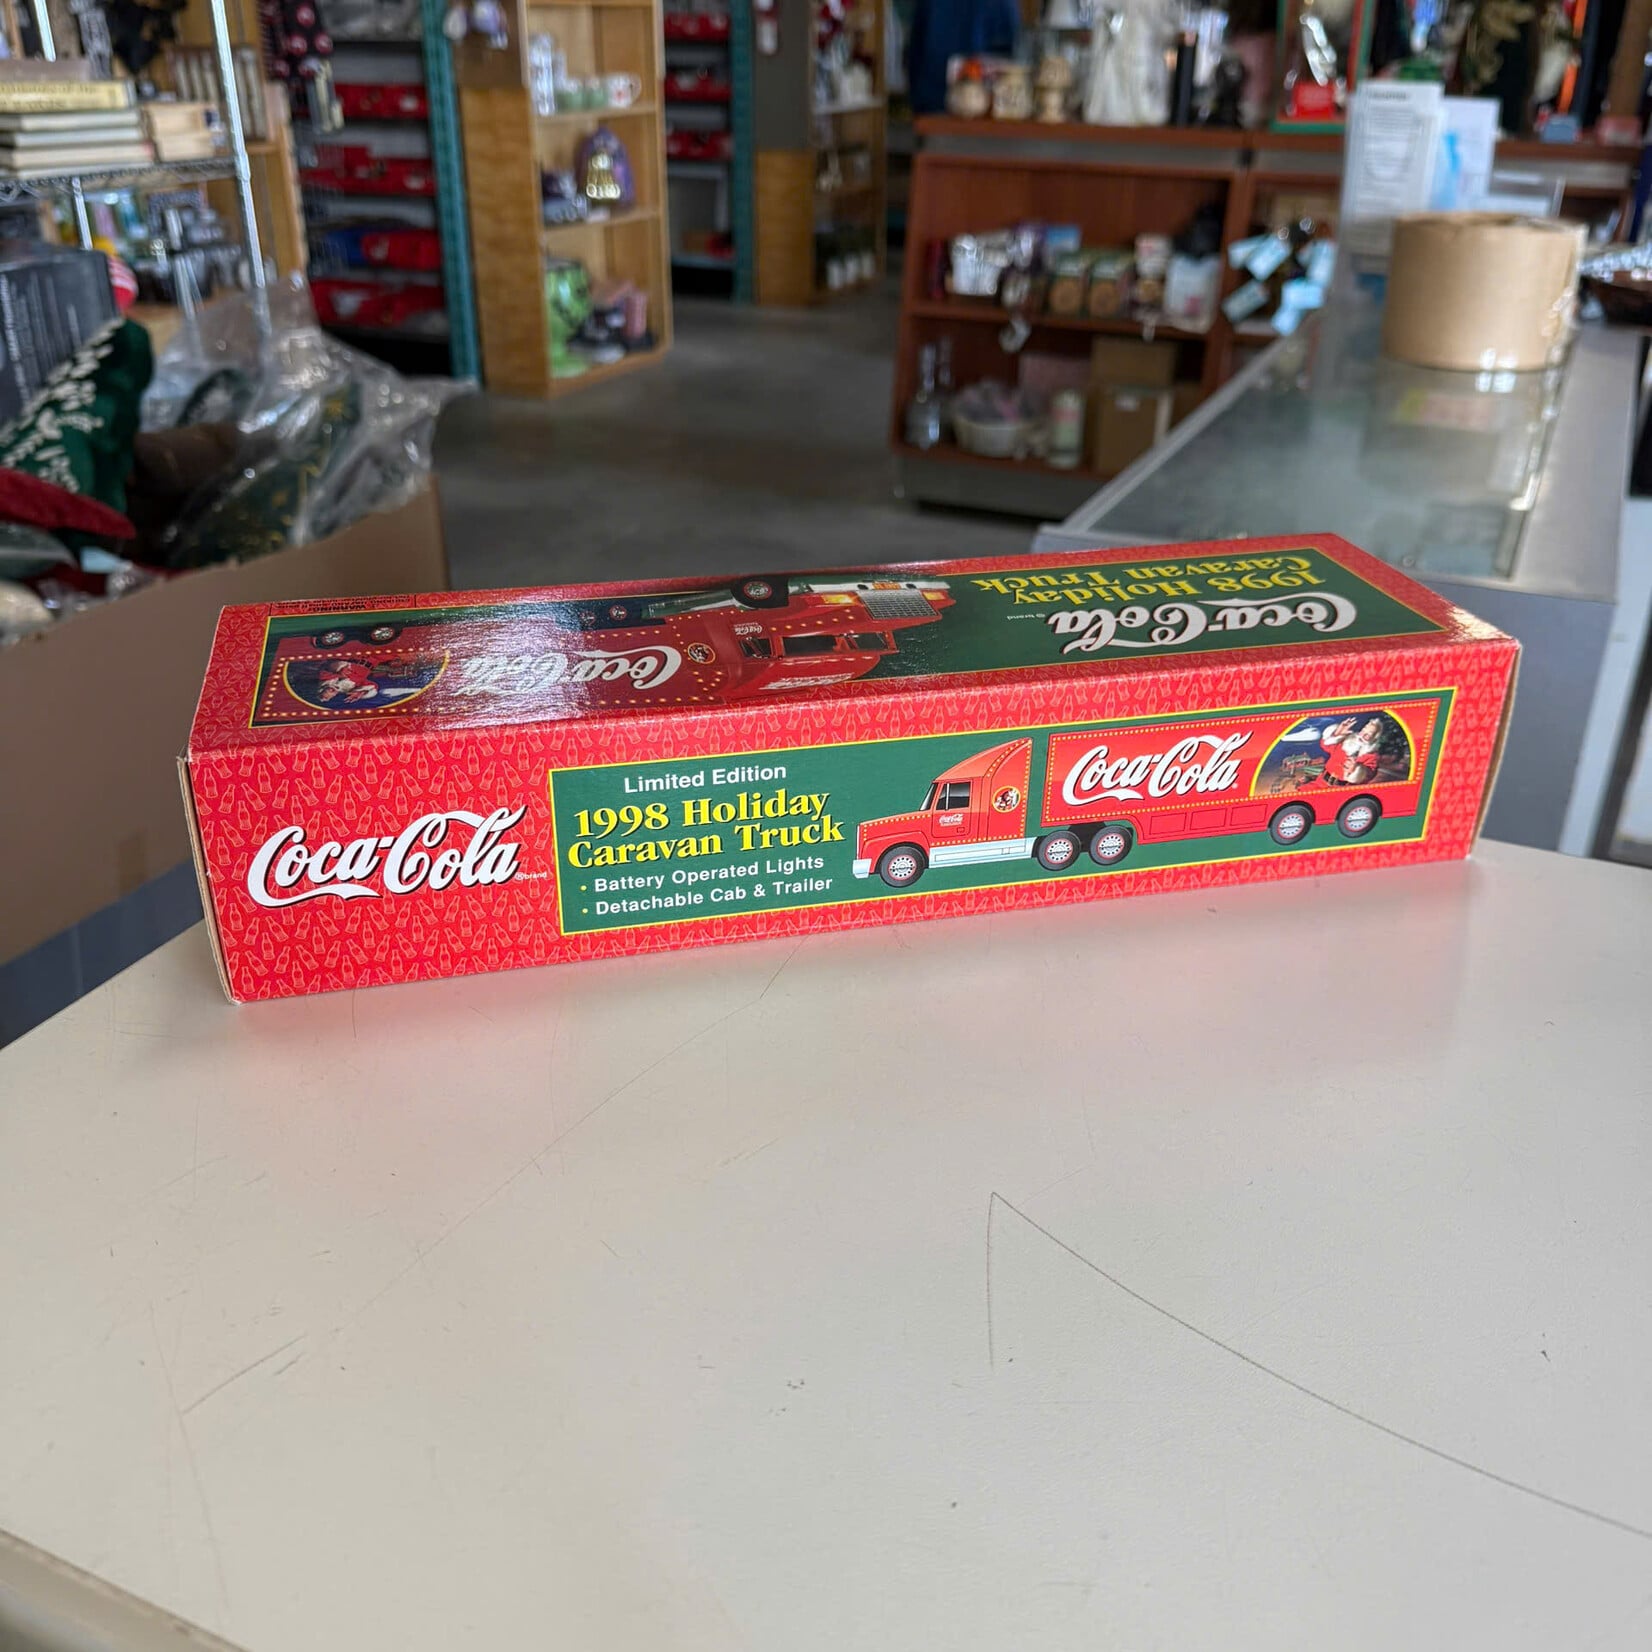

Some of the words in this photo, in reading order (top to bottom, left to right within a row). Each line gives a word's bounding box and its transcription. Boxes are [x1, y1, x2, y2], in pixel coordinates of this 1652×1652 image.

[971, 570, 1120, 596] Truck
[1122, 556, 1313, 579] Caravan
[1207, 570, 1326, 593] 1998
[1012, 579, 1203, 606] Holiday
[1048, 592, 1358, 655] Coca-Cola
[624, 770, 705, 794] Limited
[712, 764, 787, 786] Edition
[1062, 730, 1254, 806] Coca-Cola
[573, 801, 671, 839] 1998
[681, 788, 831, 828] Holiday
[247, 804, 527, 908] Coca-Cola
[567, 832, 724, 869] Caravan
[734, 814, 847, 851] Truck
[594, 873, 665, 893] Battery
[671, 861, 759, 885] Operated
[766, 856, 825, 877] Lights
[596, 892, 704, 916] Detachable
[710, 885, 747, 902] Cab
[753, 884, 767, 898] &
[772, 878, 833, 896] Trailer
